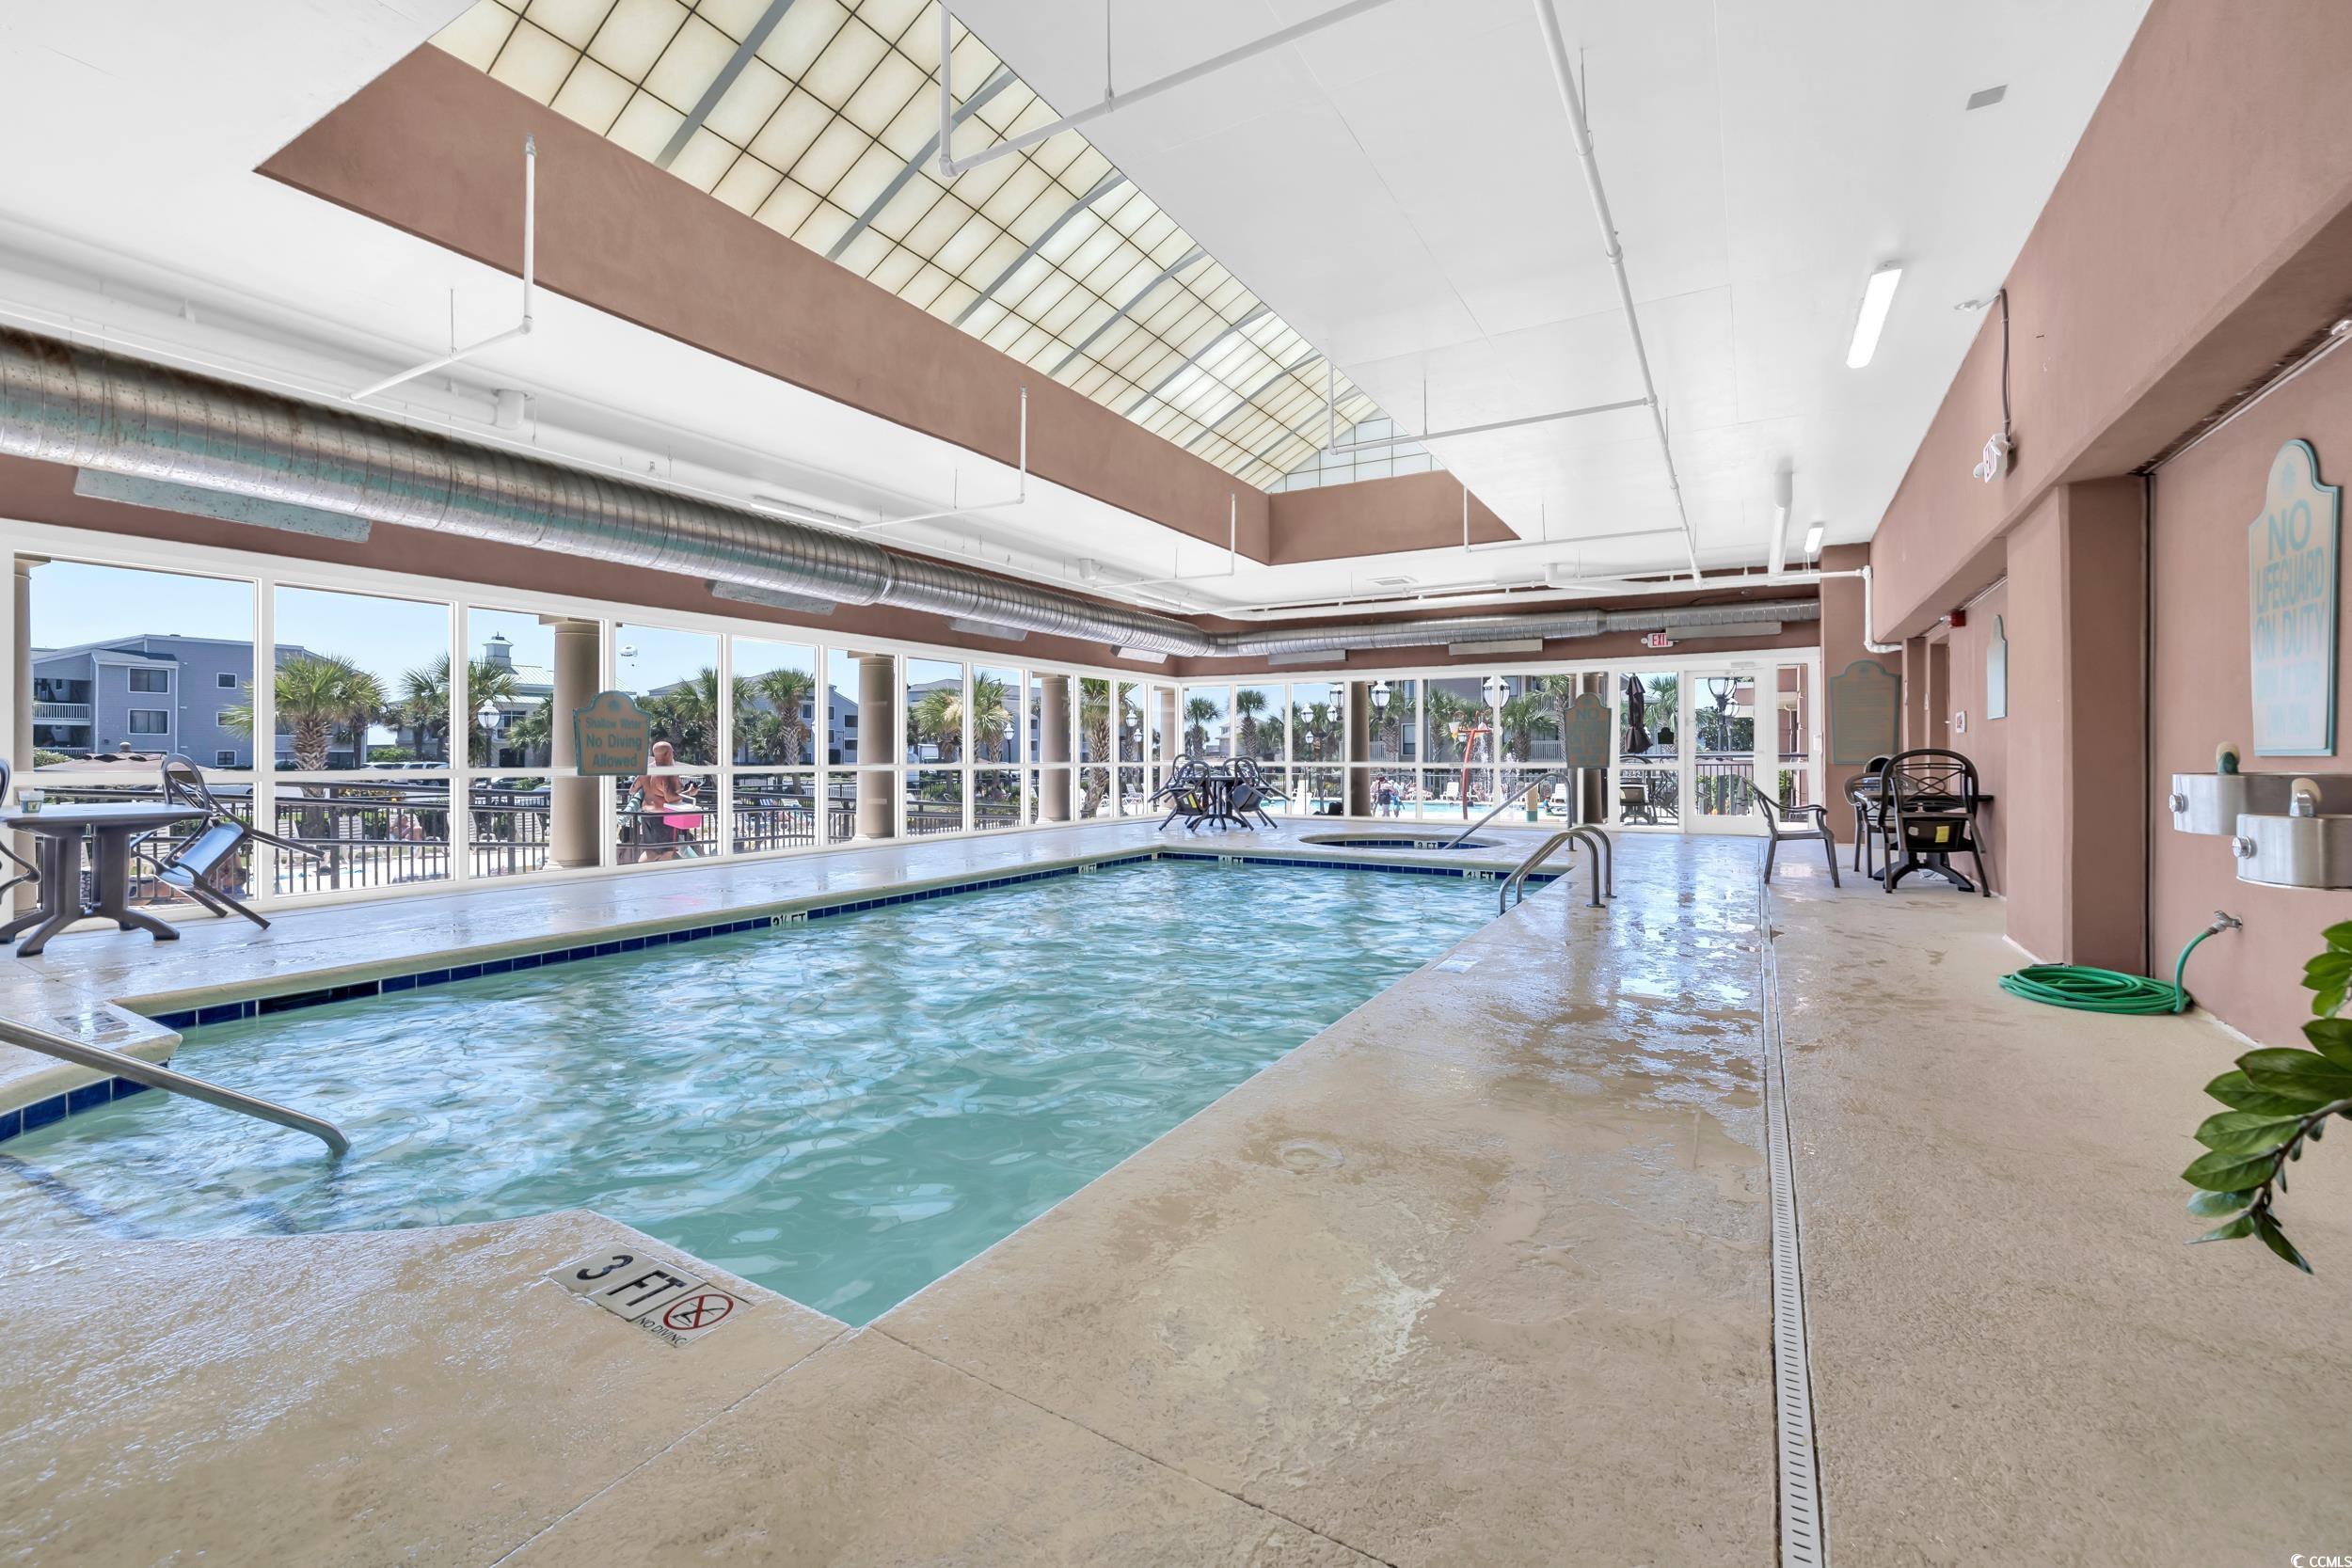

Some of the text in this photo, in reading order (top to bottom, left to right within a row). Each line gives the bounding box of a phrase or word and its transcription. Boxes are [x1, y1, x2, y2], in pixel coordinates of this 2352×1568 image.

[2267, 499, 2312, 561] NO
[2255, 546, 2325, 613] LIFEGUARD
[2255, 600, 2326, 662] ON DUTY
[586, 718, 617, 728] Shallow
[586, 734, 642, 752] No Diving
[592, 753, 637, 768] Allowed
[577, 1254, 687, 1307] 3 FT
[640, 1317, 656, 1328] NO
